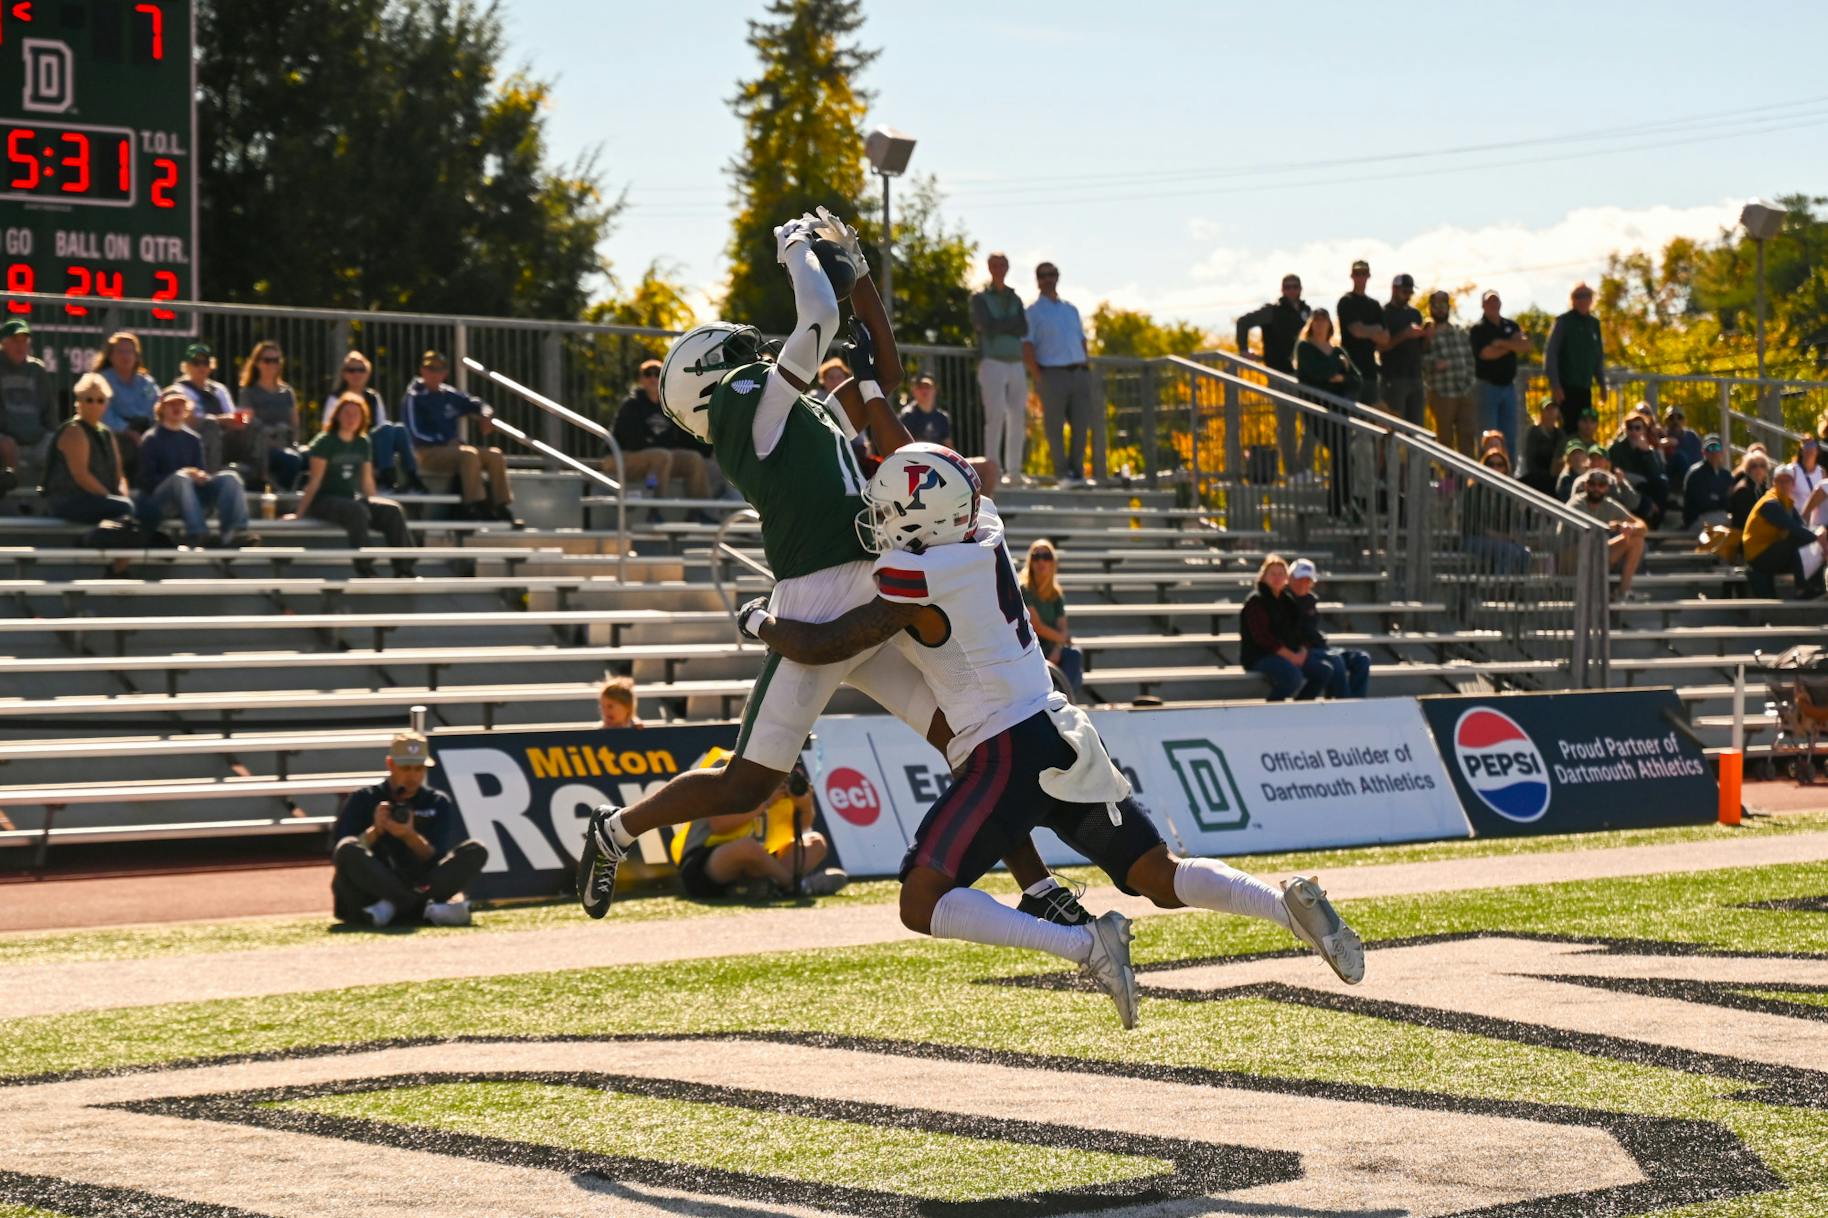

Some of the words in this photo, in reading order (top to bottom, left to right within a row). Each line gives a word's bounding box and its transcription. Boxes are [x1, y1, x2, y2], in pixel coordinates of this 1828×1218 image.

[135, 4, 163, 60] 7
[22, 38, 73, 113] D
[151, 159, 178, 208] 2
[6, 227, 32, 255] GO
[55, 229, 100, 258] BALL
[104, 232, 131, 260] ON
[139, 235, 189, 263] QTR.
[1260, 749, 1326, 773] Official
[1329, 745, 1390, 768] Builder
[1395, 743, 1413, 762] of
[1558, 737, 1605, 760] Proud
[1606, 736, 1661, 759] Partner
[1663, 731, 1679, 753] of
[525, 745, 679, 779] Milton
[1462, 751, 1542, 778] PEPSI
[1553, 763, 1637, 784] Dartmouth
[1638, 756, 1704, 779] Athletics
[829, 780, 878, 809] eci
[1162, 738, 1251, 833] D
[1260, 778, 1357, 802] Dartmouth
[1360, 772, 1436, 795] Athletics
